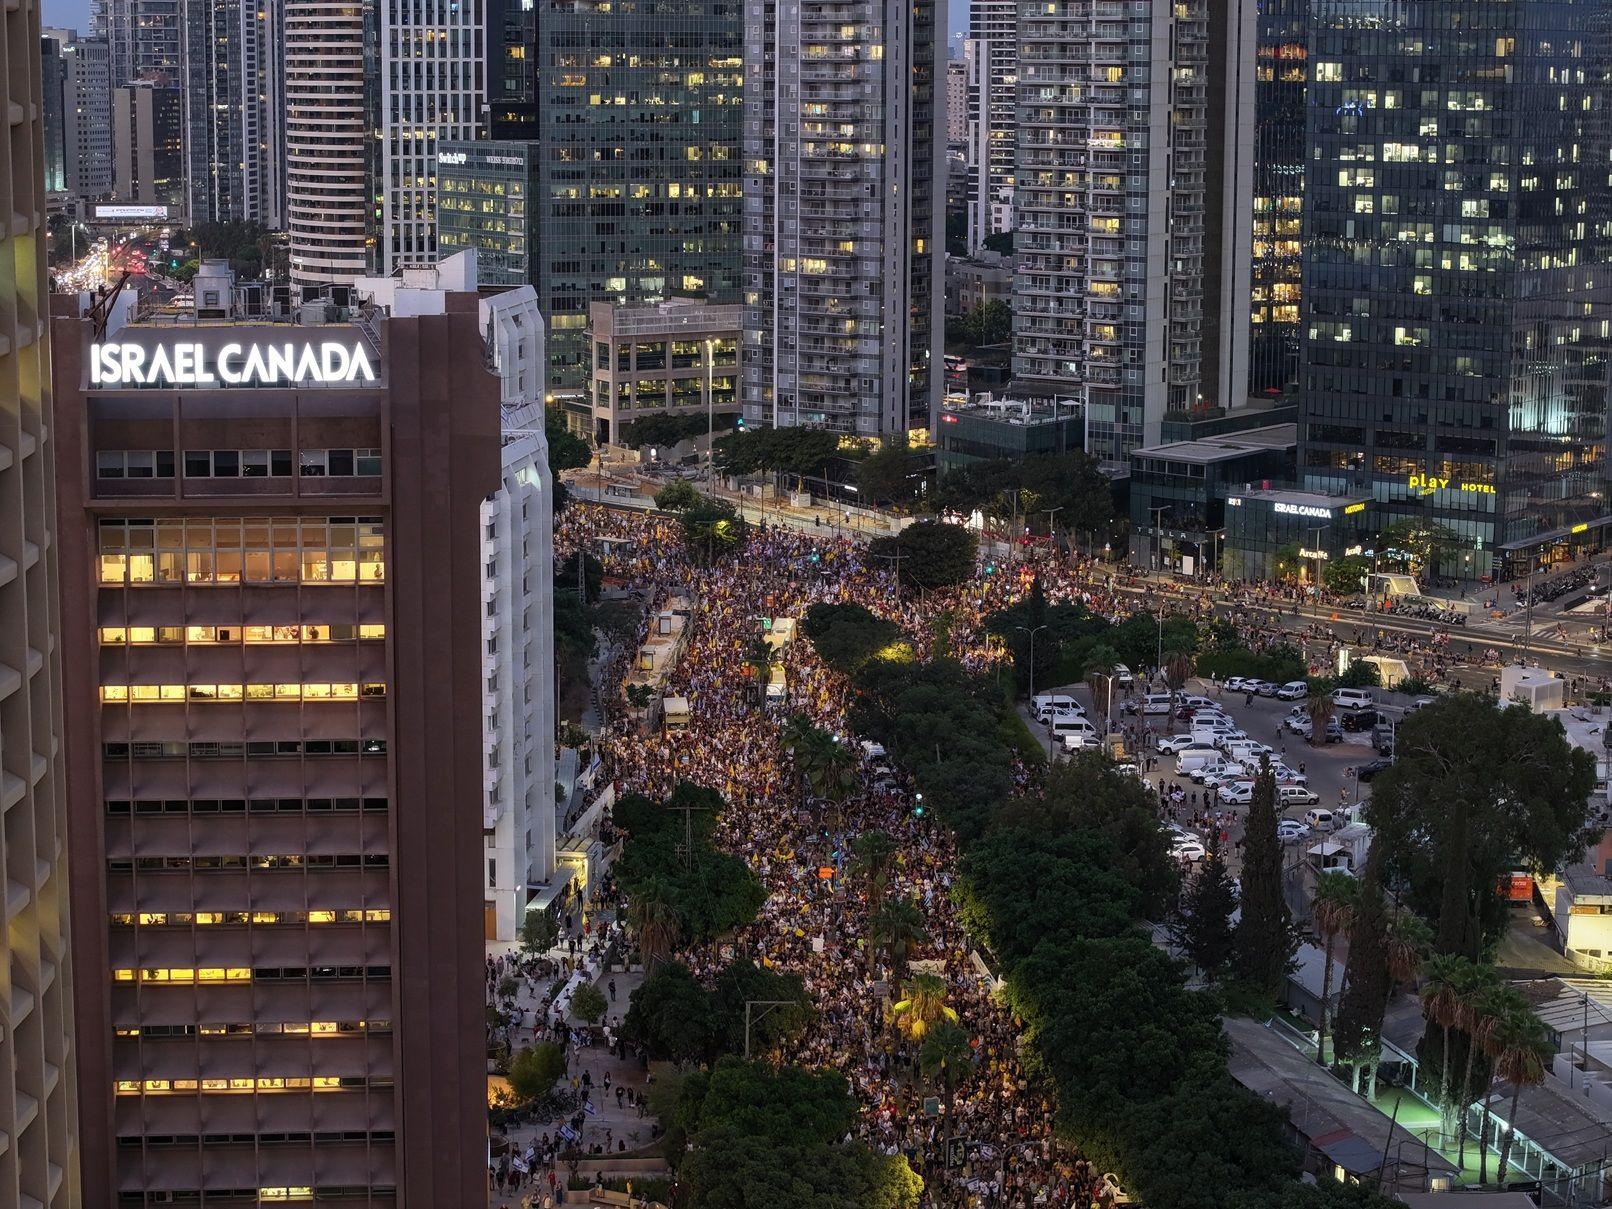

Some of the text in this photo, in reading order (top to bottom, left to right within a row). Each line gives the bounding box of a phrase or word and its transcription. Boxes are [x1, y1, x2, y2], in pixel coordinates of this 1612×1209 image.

[90, 341, 376, 384] ISRAEL CANADA
[1461, 483, 1496, 494] HOTEL
[1274, 503, 1331, 518] ISRAEL CANADA
